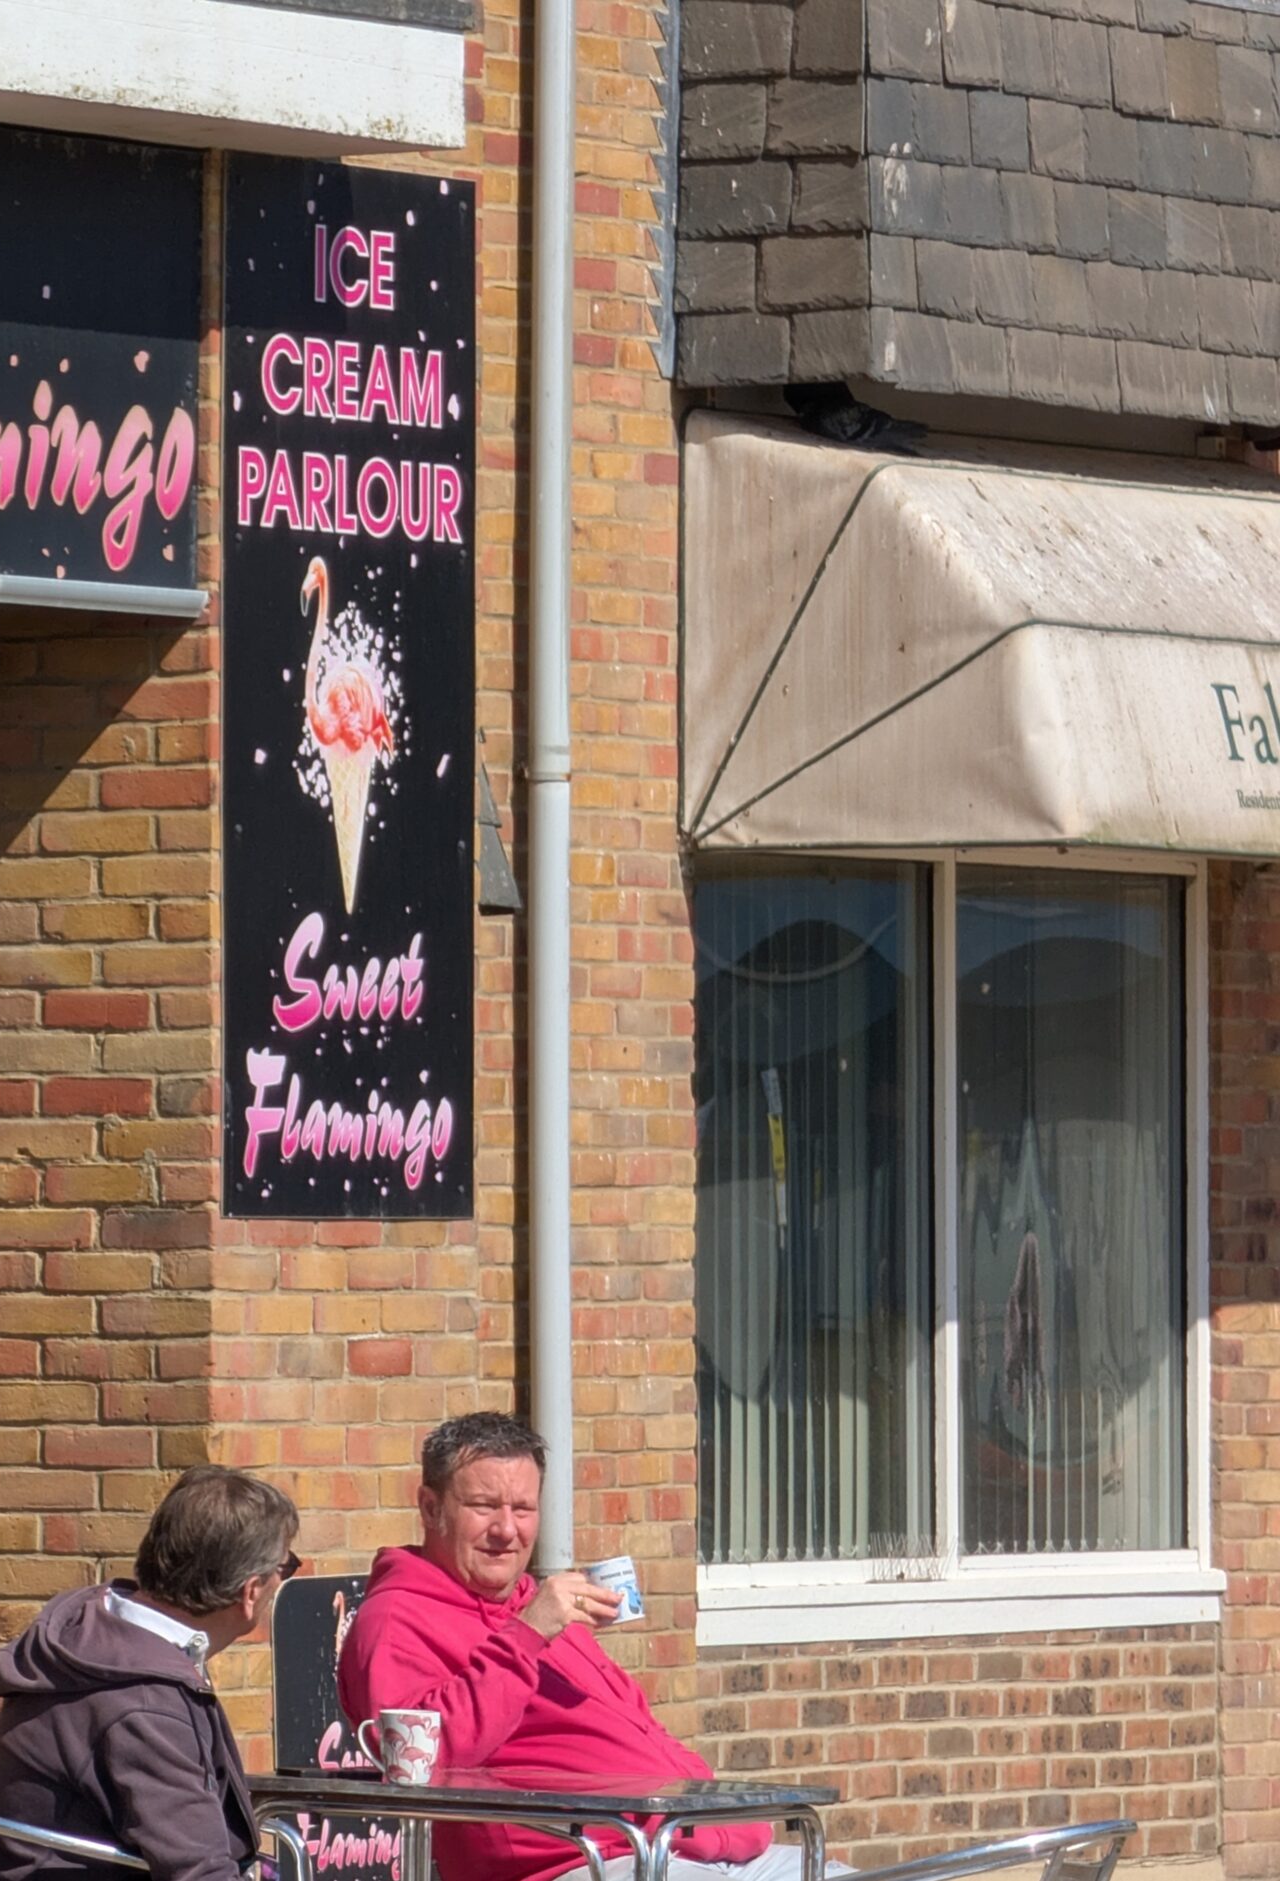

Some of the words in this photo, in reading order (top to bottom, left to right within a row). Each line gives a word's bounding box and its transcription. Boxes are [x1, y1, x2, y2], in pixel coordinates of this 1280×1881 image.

[314, 223, 395, 311] ICE
[261, 332, 443, 429] CREAM
[237, 445, 463, 545] PARLOUR
[272, 911, 424, 1032] Sweet
[243, 1047, 453, 1190] Flamingo
[296, 1812, 402, 1881] Flaming
